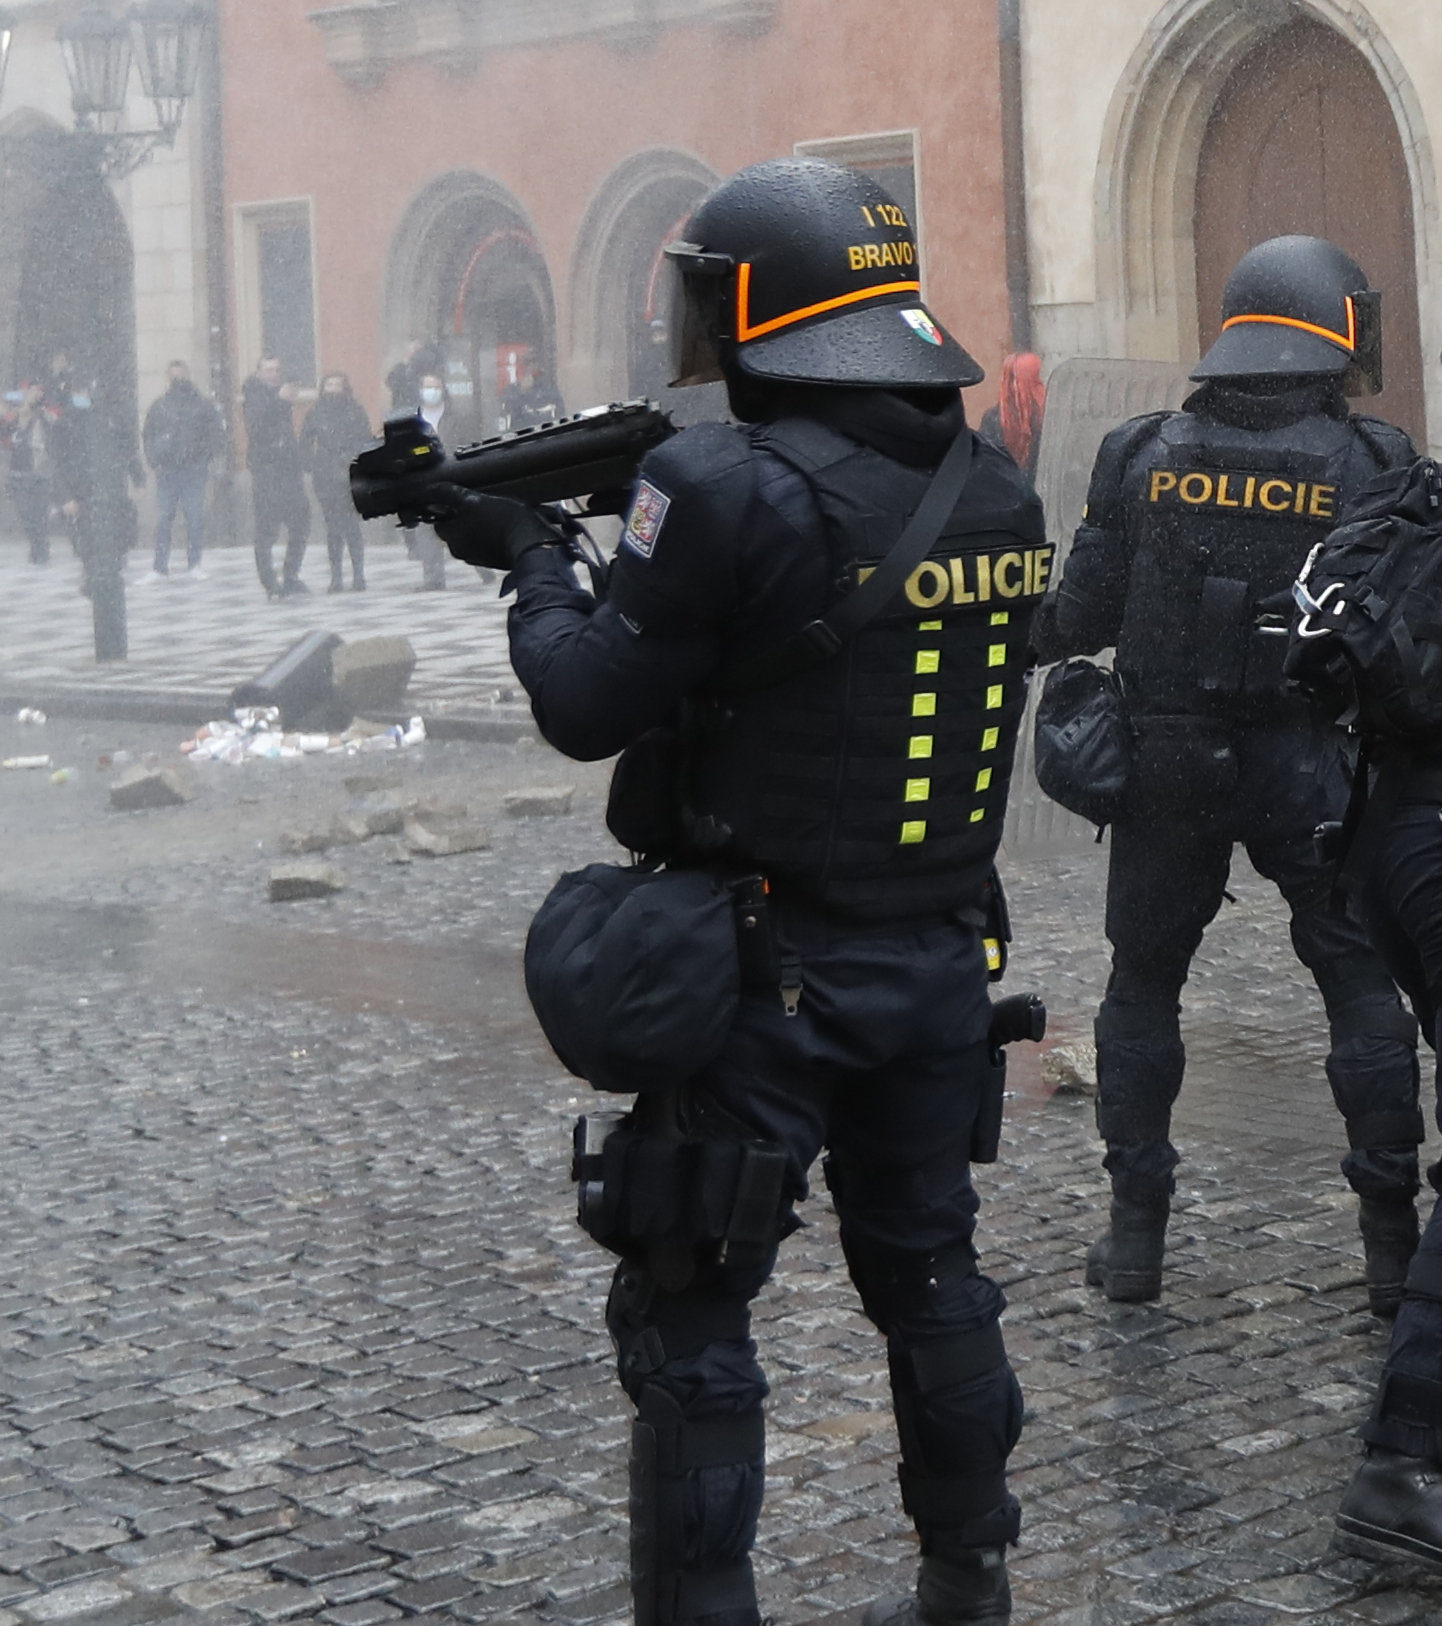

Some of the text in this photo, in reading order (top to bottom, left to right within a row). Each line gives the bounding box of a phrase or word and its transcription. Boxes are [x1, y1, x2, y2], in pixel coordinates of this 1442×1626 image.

[861, 205, 876, 227] I
[847, 241, 913, 271] BRAVO
[1150, 470, 1336, 518] POLICIE
[858, 547, 1052, 609] OLICIE
